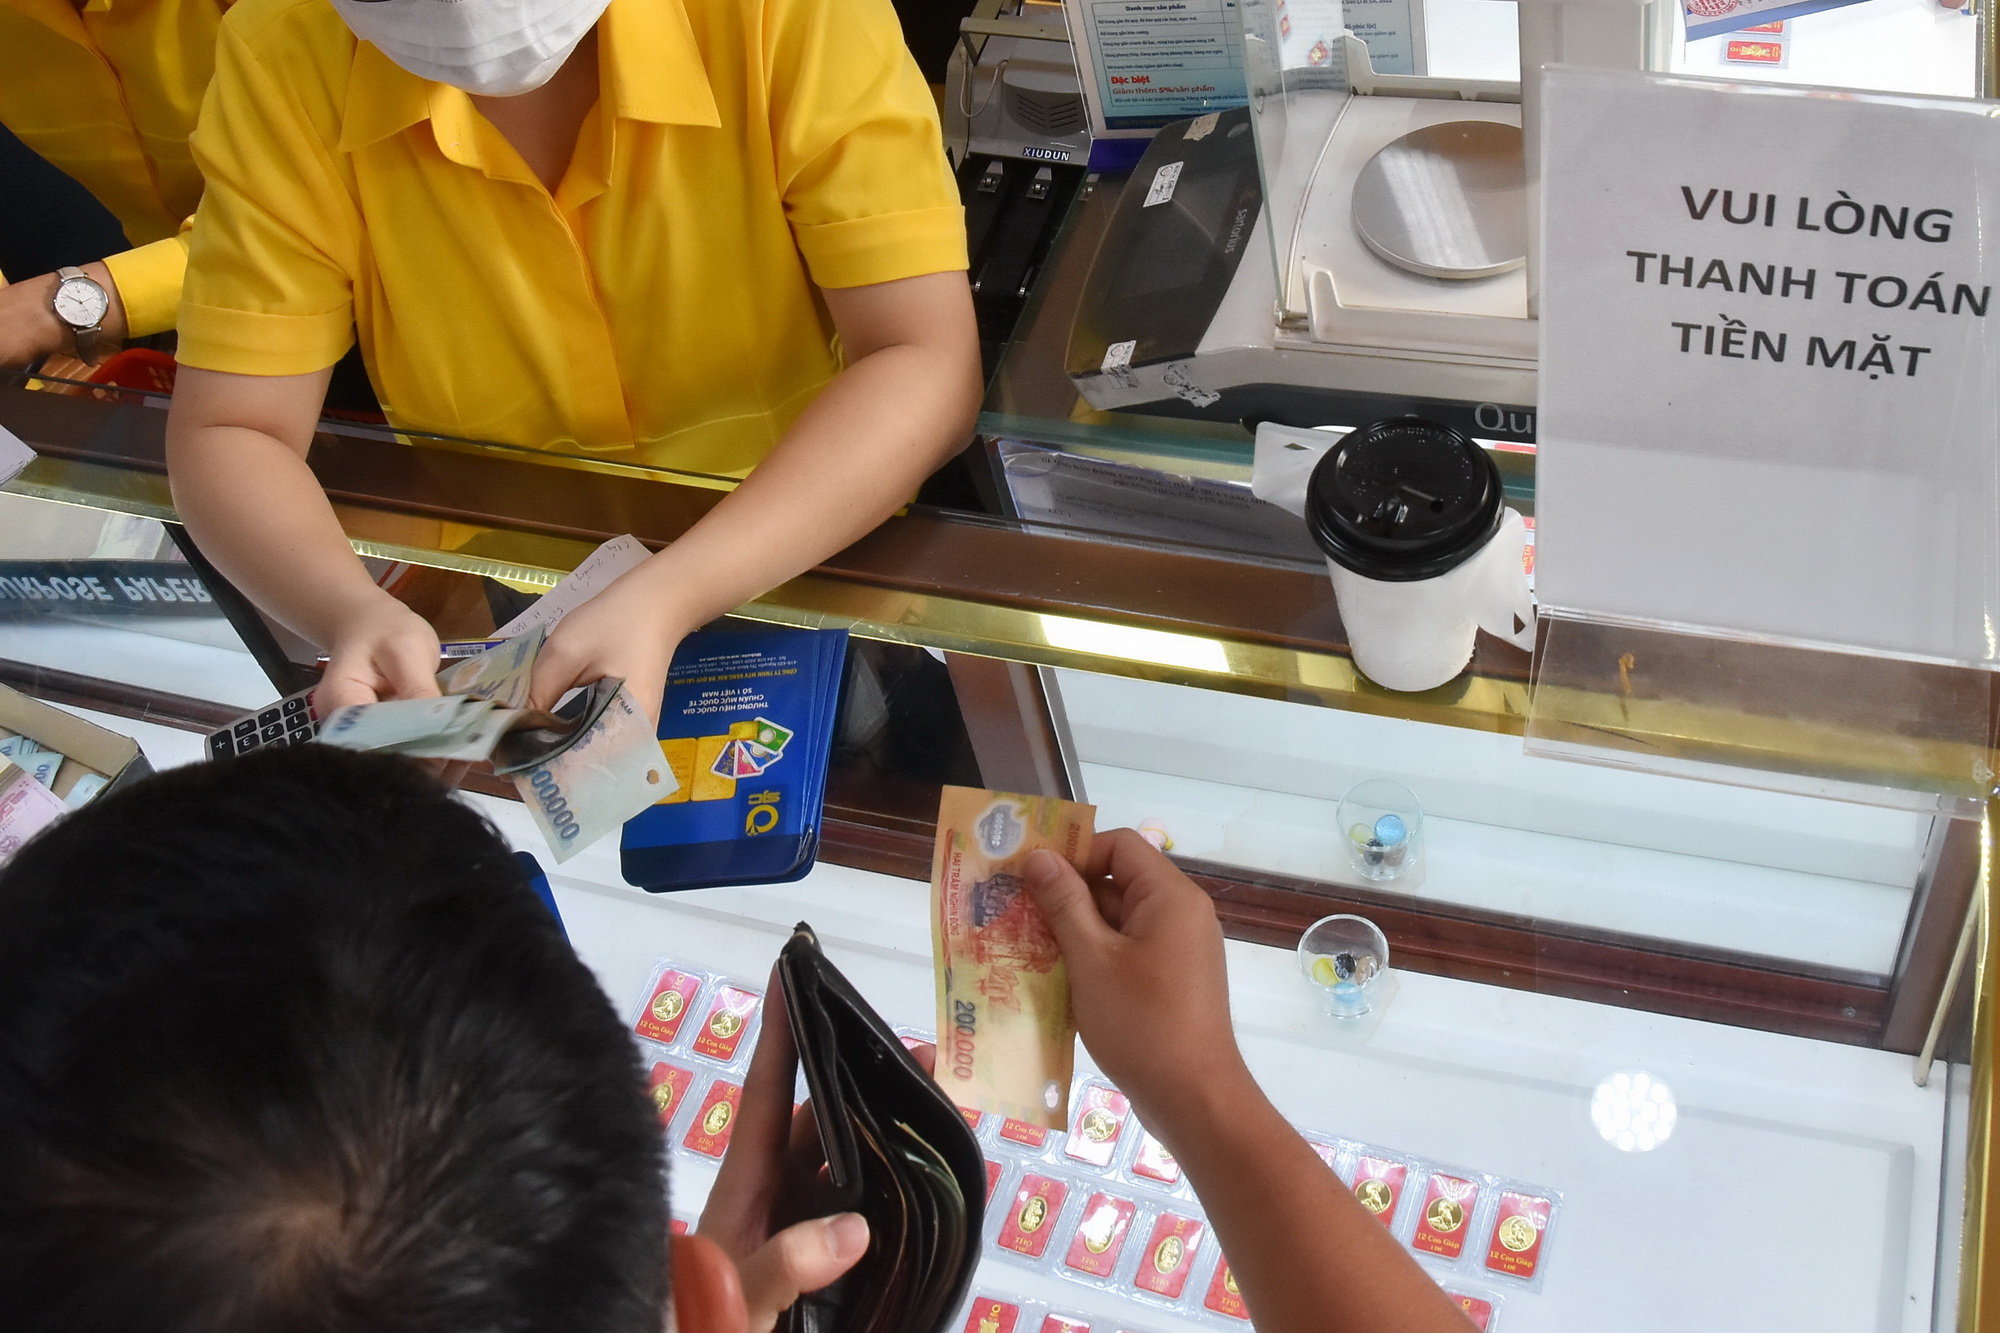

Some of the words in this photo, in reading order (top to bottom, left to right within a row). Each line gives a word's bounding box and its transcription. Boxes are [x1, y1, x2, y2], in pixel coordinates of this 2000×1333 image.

[1111, 76, 1129, 85] Đặc
[1113, 87, 1134, 95] Giảm
[1023, 148, 1070, 161] XIUDUN
[1680, 186, 1776, 227] VUI
[1796, 190, 1954, 244] LÒNG
[1225, 208, 1247, 254] sartorius
[1626, 250, 1816, 300] THANH
[1835, 271, 1992, 318] TOÁN
[1670, 314, 1787, 363] TIỀN
[1806, 334, 1932, 381] MẶT
[1475, 402, 1533, 434] Qu
[720, 689, 737, 697] VIỆT
[288, 700, 296, 709] 0
[620, 699, 634, 716] NAM
[699, 698, 720, 706] QUỐC
[738, 702, 769, 711] THƯƠNG
[697, 706, 719, 714] QUỐC
[719, 705, 736, 713] HIỆU
[268, 726, 276, 735] 2
[295, 731, 303, 740] 4
[242, 737, 251, 747] 3
[952, 852, 962, 866] HAI
[962, 1110, 977, 1121] Giáp
[1005, 1122, 1014, 1130] 12
[1014, 1124, 1028, 1134] Con
[1029, 1128, 1044, 1139] Giáp
[1418, 1232, 1427, 1240] 12
[1428, 1235, 1442, 1245] Con
[1443, 1238, 1460, 1249] Giáp
[1490, 1250, 1499, 1259] 12
[1501, 1253, 1515, 1263] Con
[1516, 1257, 1533, 1268] Giáp
